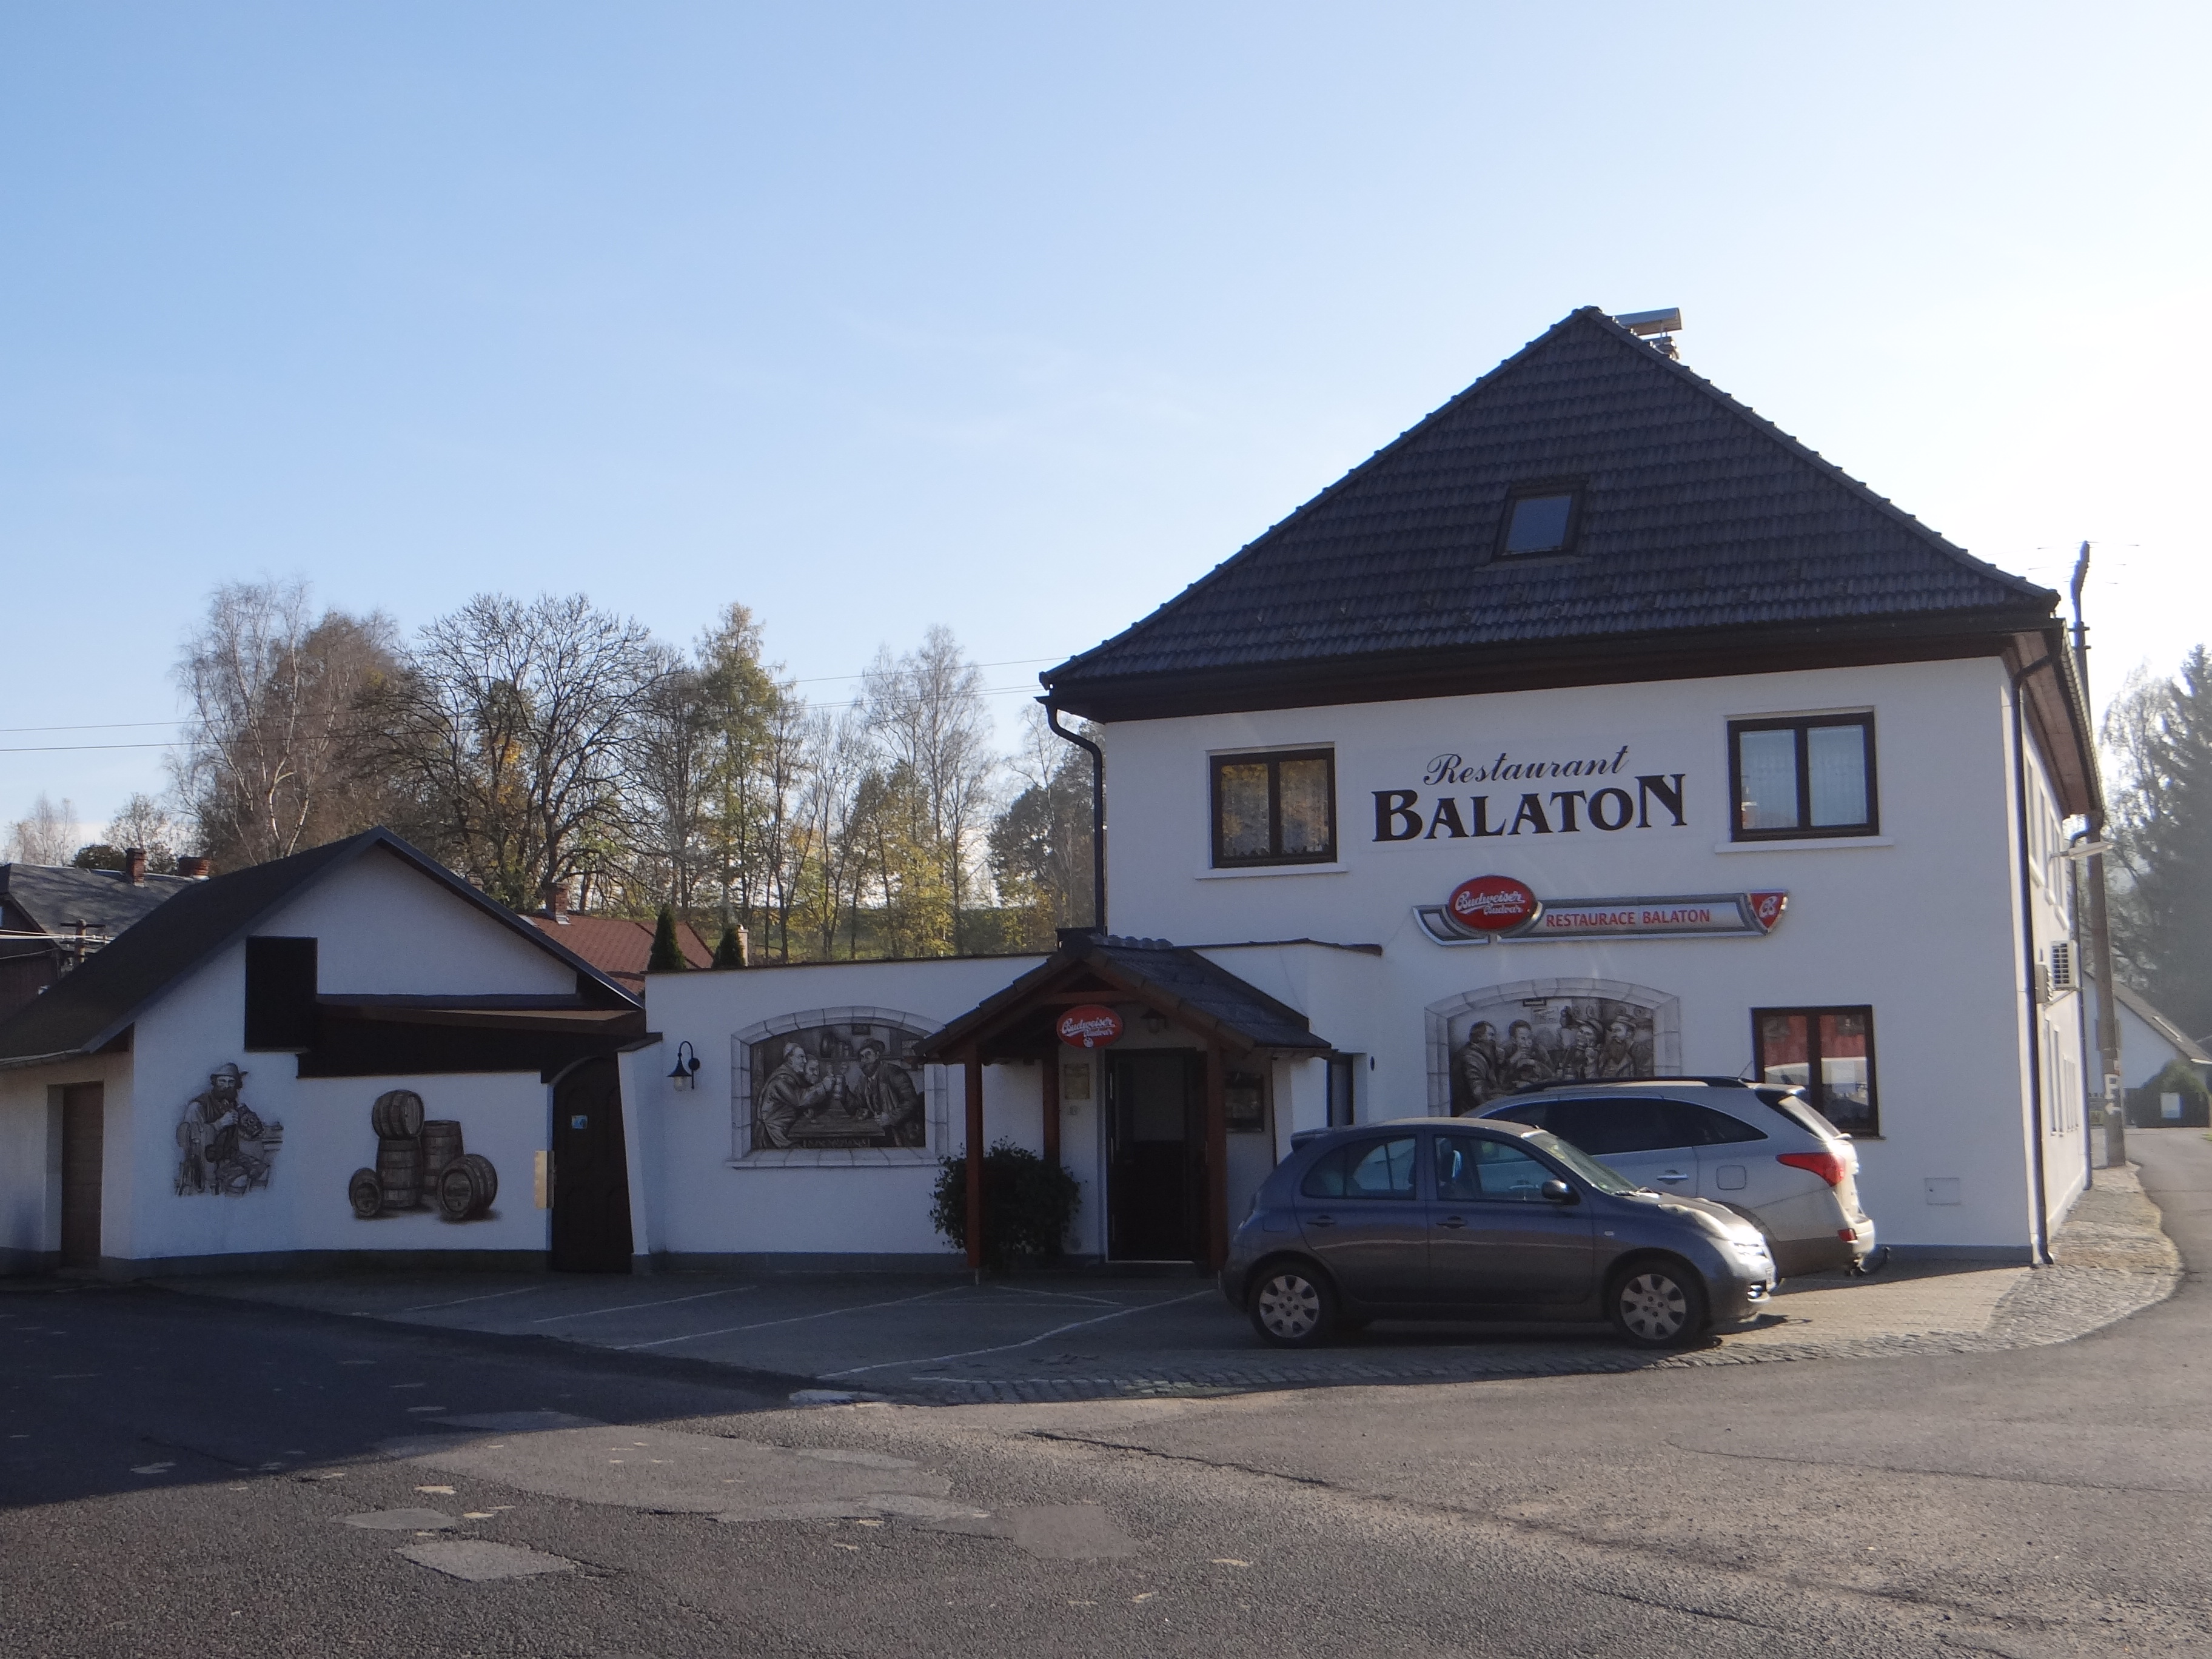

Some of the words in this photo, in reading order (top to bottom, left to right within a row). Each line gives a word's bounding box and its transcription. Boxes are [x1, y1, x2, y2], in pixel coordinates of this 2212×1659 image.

[1423, 745, 1629, 785] Restaurant
[1371, 773, 1687, 842] BALATON
[1455, 891, 1526, 914] Budweiser
[1483, 903, 1523, 916] Budvar
[1546, 912, 1635, 927] RESTAURACE
[1643, 909, 1711, 924] BALATON
[1062, 1017, 1116, 1036] Budweiser
